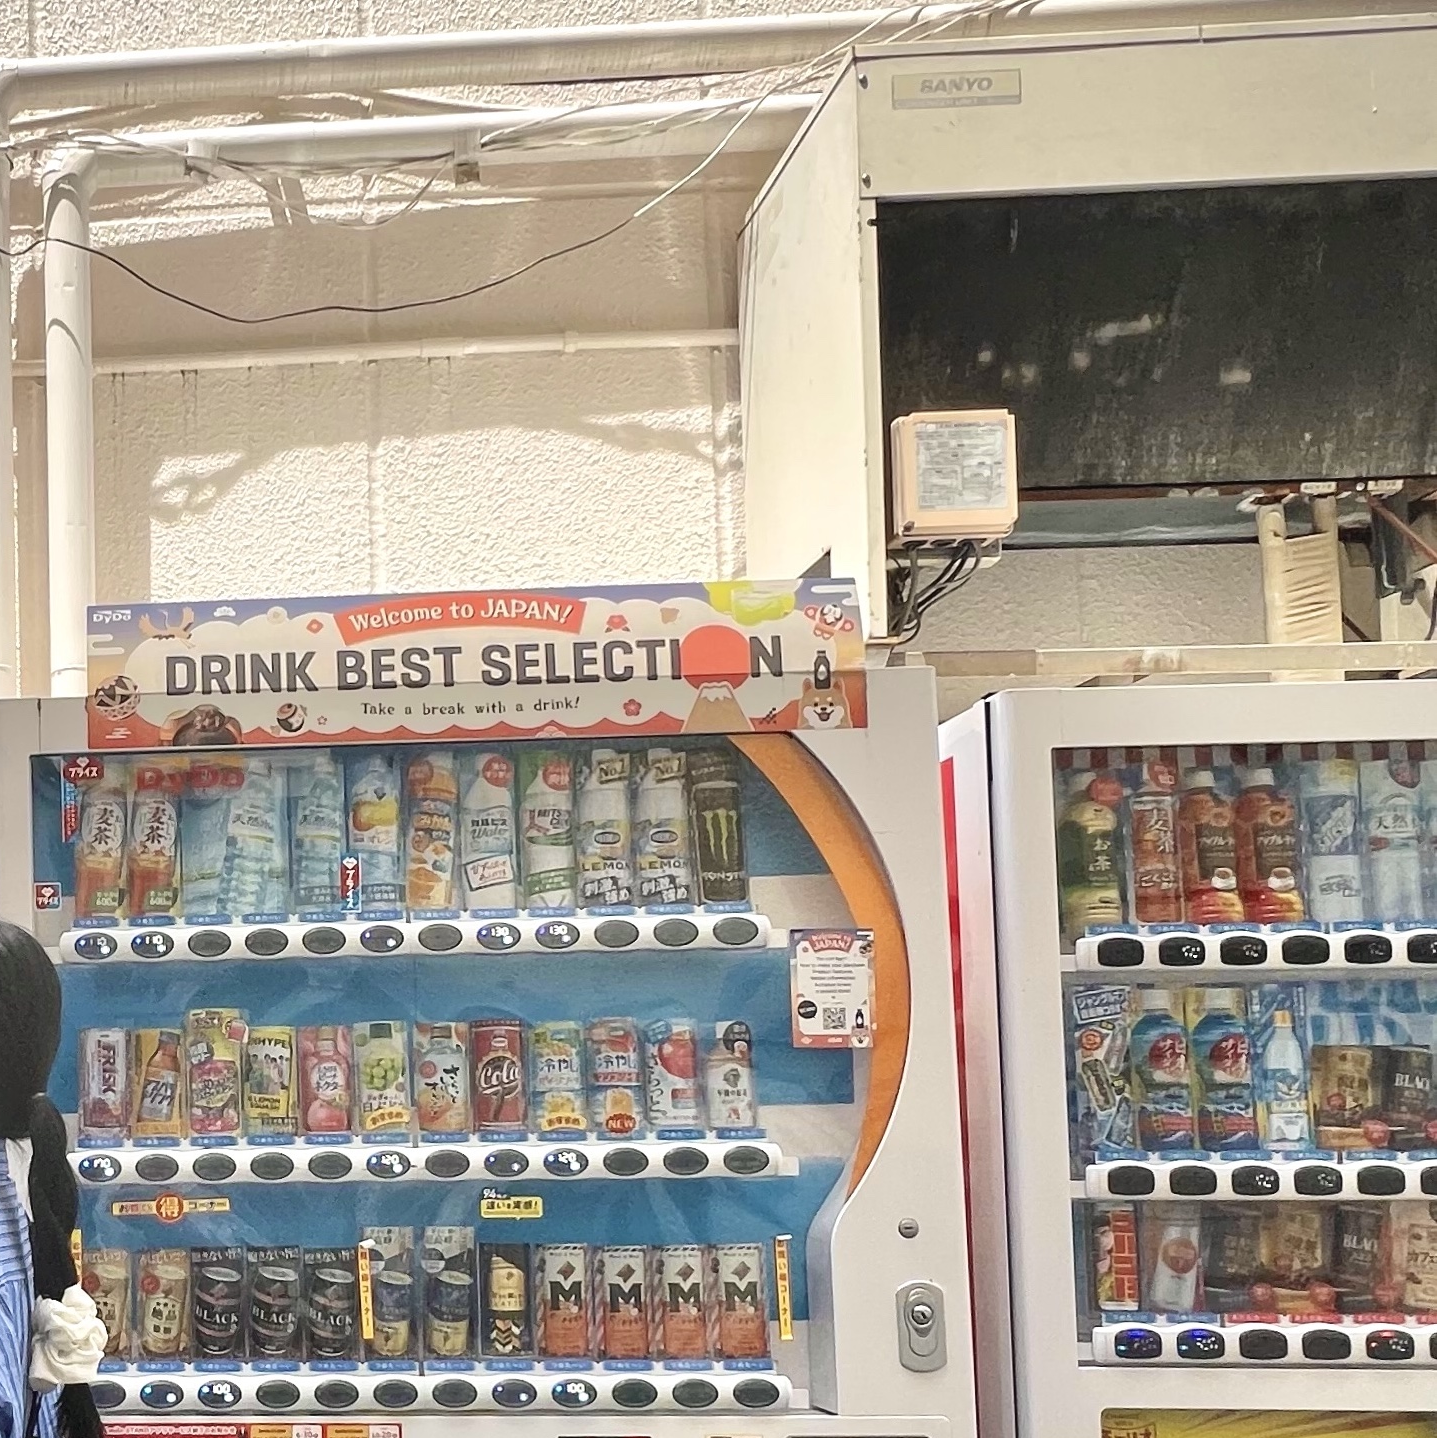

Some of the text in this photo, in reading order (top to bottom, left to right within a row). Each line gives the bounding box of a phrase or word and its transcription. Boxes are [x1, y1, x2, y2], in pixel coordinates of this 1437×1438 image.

[920, 76, 994, 95] SANYO
[92, 609, 132, 624] DyDo
[347, 597, 575, 633] Welcome to JAPAN!
[165, 650, 319, 697] DRINK
[336, 646, 463, 691] BEST
[362, 696, 580, 716] Take a break with a drink!
[1088, 838, 1112, 872] お茶
[248, 1036, 292, 1048] NHYPE
[479, 1065, 520, 1090] Cola
[1393, 1073, 1431, 1090] BLAC
[606, 1118, 635, 1131] NEW
[1343, 1234, 1378, 1250] BLAC
[549, 1280, 582, 1311] M
[608, 1282, 643, 1313] M
[667, 1281, 702, 1312] M
[723, 1281, 759, 1312] M
[195, 1306, 238, 1326] BLACK
[252, 1306, 297, 1325] BLACK
[309, 1306, 353, 1326] BLACK
